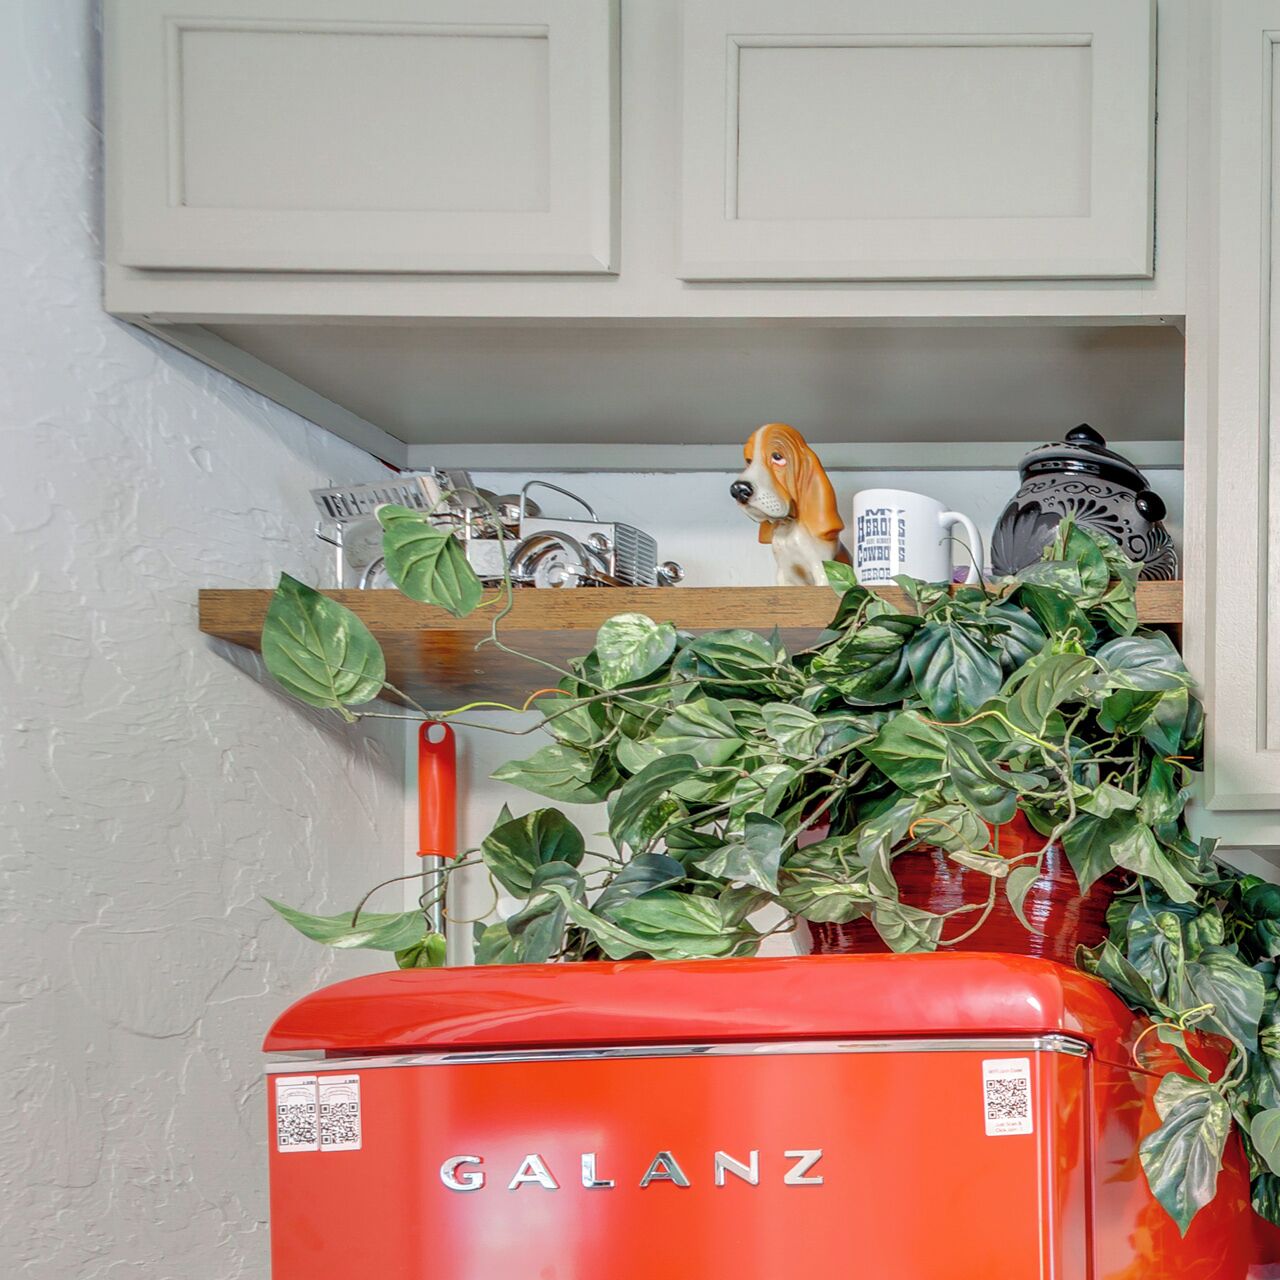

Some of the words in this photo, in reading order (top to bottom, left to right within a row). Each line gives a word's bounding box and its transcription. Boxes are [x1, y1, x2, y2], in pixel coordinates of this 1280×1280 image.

[858, 515, 906, 543] HEROS
[858, 544, 906, 568] COWBOS
[440, 1148, 825, 1192] GALANZ
